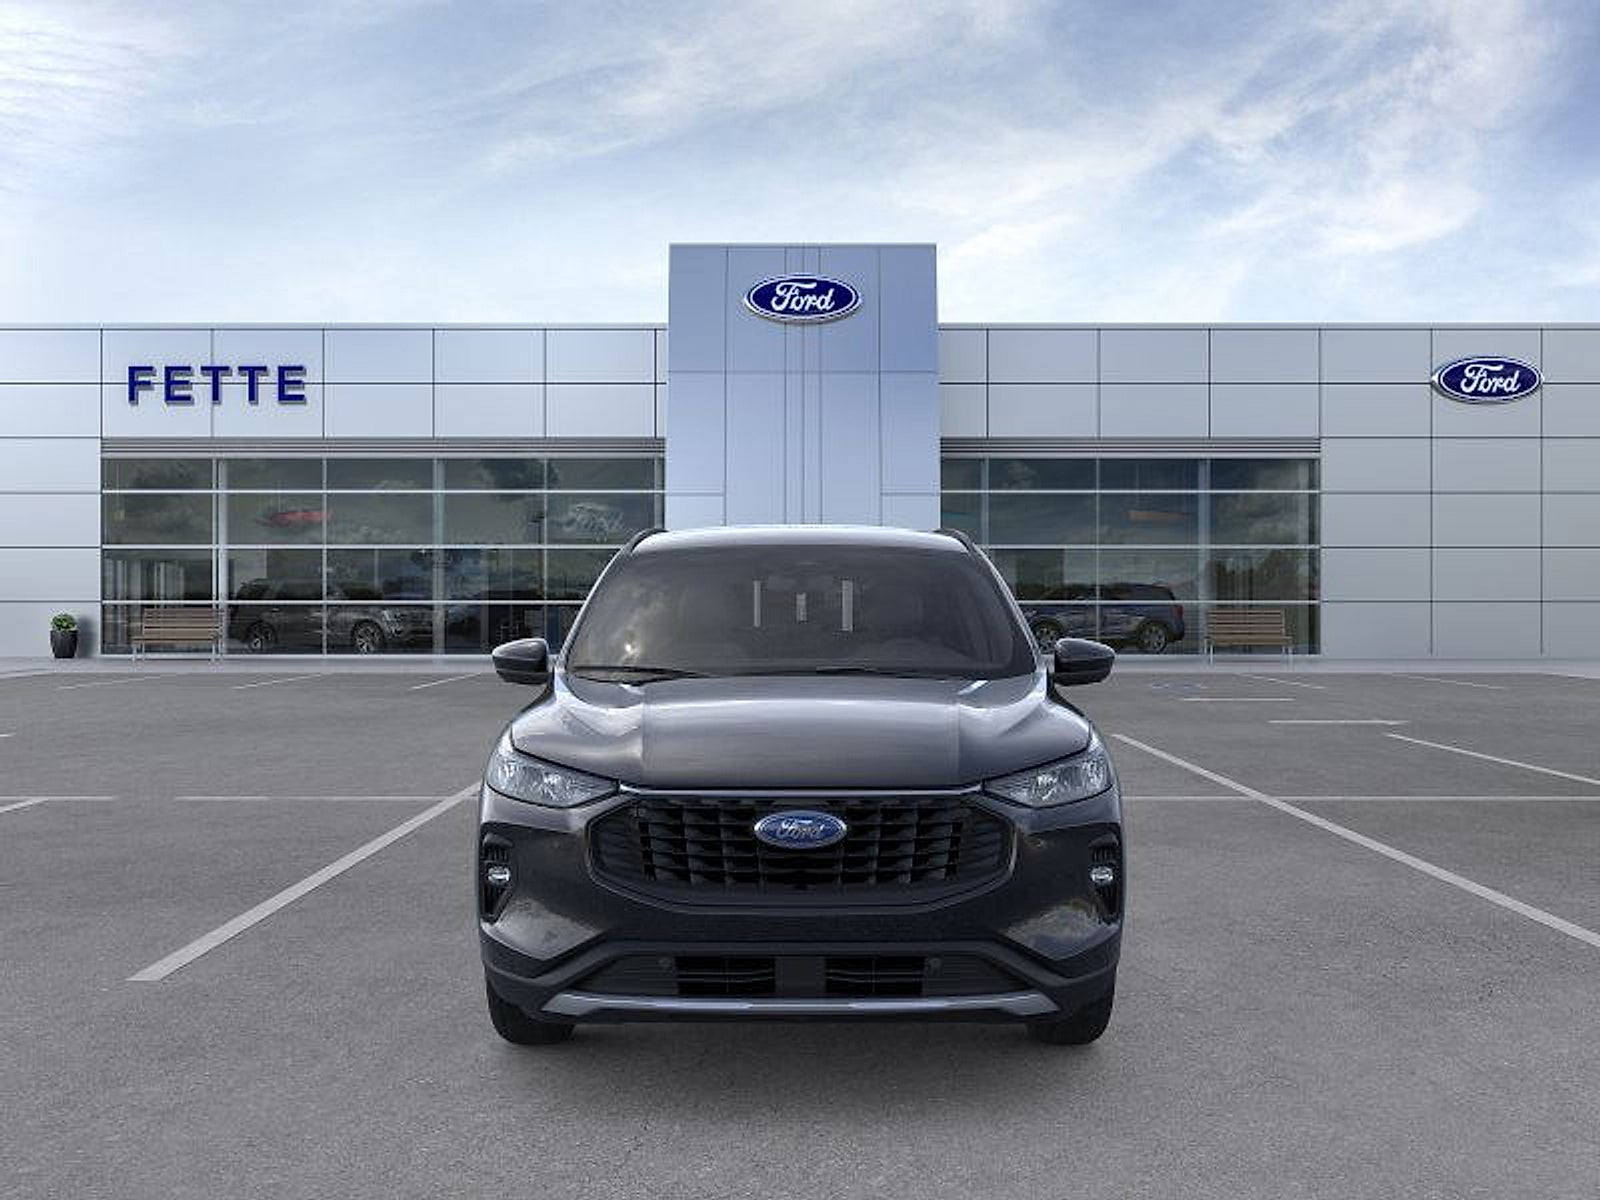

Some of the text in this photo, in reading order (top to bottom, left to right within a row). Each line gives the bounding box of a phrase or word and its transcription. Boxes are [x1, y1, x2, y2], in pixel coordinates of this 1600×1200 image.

[771, 282, 835, 311] Ford
[128, 365, 306, 405] FETTE
[1461, 364, 1521, 393] Ford
[777, 818, 825, 839] Ford
